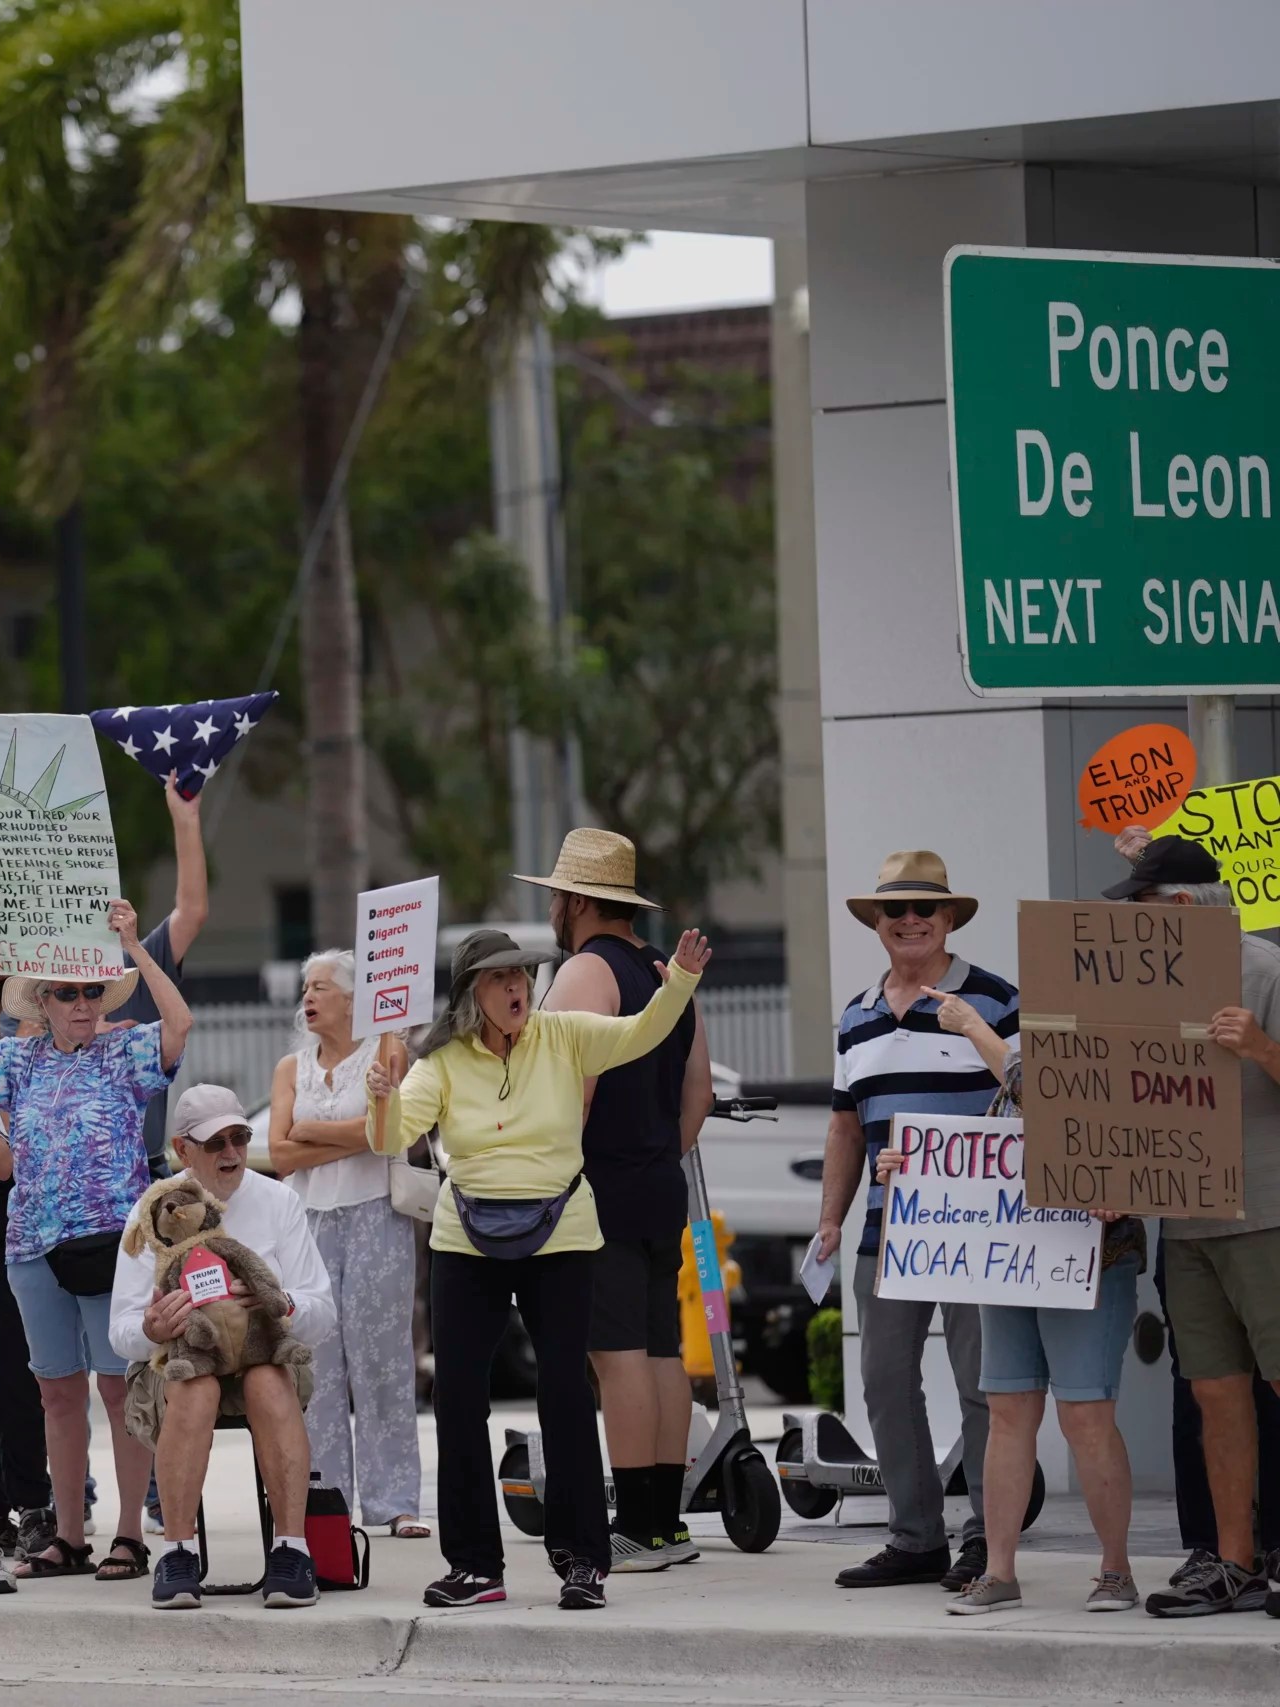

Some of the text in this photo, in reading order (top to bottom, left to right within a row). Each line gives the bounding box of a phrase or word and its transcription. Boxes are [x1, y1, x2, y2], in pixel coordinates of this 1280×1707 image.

[1048, 301, 1229, 393] Ponce
[1016, 429, 1271, 518] De Leon
[984, 578, 1102, 645] NEXT
[1088, 742, 1174, 788] ELON
[1124, 774, 1150, 789] AND
[1089, 771, 1184, 824] TRUMP
[27, 809, 67, 822] TIRED,
[70, 811, 101, 821] YOUR
[10, 822, 68, 832] HUDDLED
[46, 833, 62, 842] TO
[67, 833, 115, 844] BREATHE
[2, 847, 72, 856] WRETCHED
[77, 848, 114, 857] REFUSE
[37, 869, 64, 880] THE
[1232, 857, 1280, 875] OUR
[17, 884, 44, 896] THE
[35, 897, 46, 908] I
[51, 897, 83, 910] LIFT
[89, 898, 111, 912] MY
[368, 900, 422, 921] Dangerous
[64, 913, 95, 925] THE
[367, 923, 408, 941] Oligarch
[1073, 911, 1183, 947] ELON
[35, 942, 104, 965] CALLED
[367, 945, 404, 962] Gutting
[16, 960, 45, 974] LADY
[50, 962, 95, 978] LIBERTY
[98, 964, 124, 977] BACK
[366, 963, 419, 984] Everything
[1073, 949, 1184, 987] MUSK
[379, 997, 403, 1010] ELON
[1031, 1031, 1206, 1067] MIND YOUR
[1038, 1065, 1216, 1110] OWN DAMN
[1064, 1117, 1211, 1168] BUSINESS,
[1043, 1163, 1113, 1204] NOT
[890, 1186, 992, 1228] Medicare,
[693, 1235, 708, 1279] BIRD
[985, 1241, 1041, 1291] FAA,
[191, 1268, 219, 1281] TRUMP
[194, 1278, 221, 1290] &ELON
[705, 1304, 714, 1321] lyft
